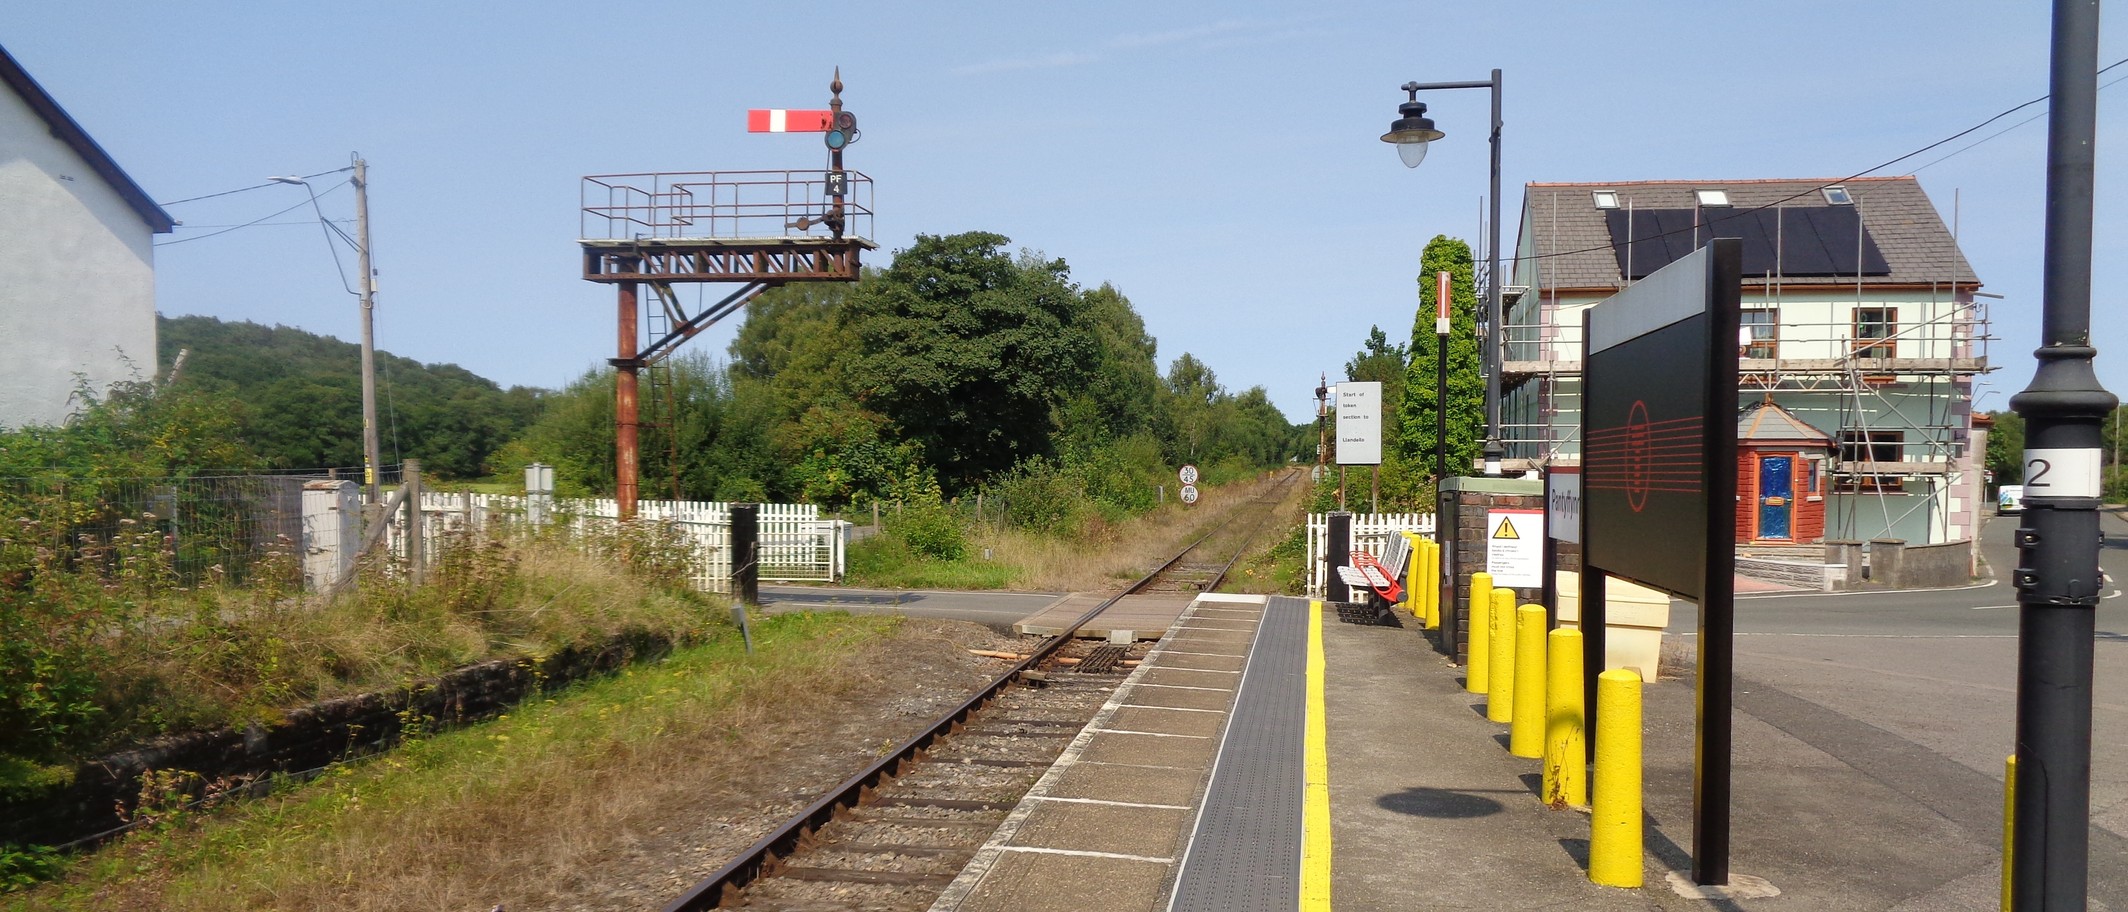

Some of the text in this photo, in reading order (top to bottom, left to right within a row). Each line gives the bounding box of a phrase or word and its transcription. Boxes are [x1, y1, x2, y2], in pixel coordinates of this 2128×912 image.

[830, 174, 842, 183] PF
[833, 184, 840, 193] 4
[2023, 458, 2051, 487] 2
[1184, 494, 1195, 502] 60
